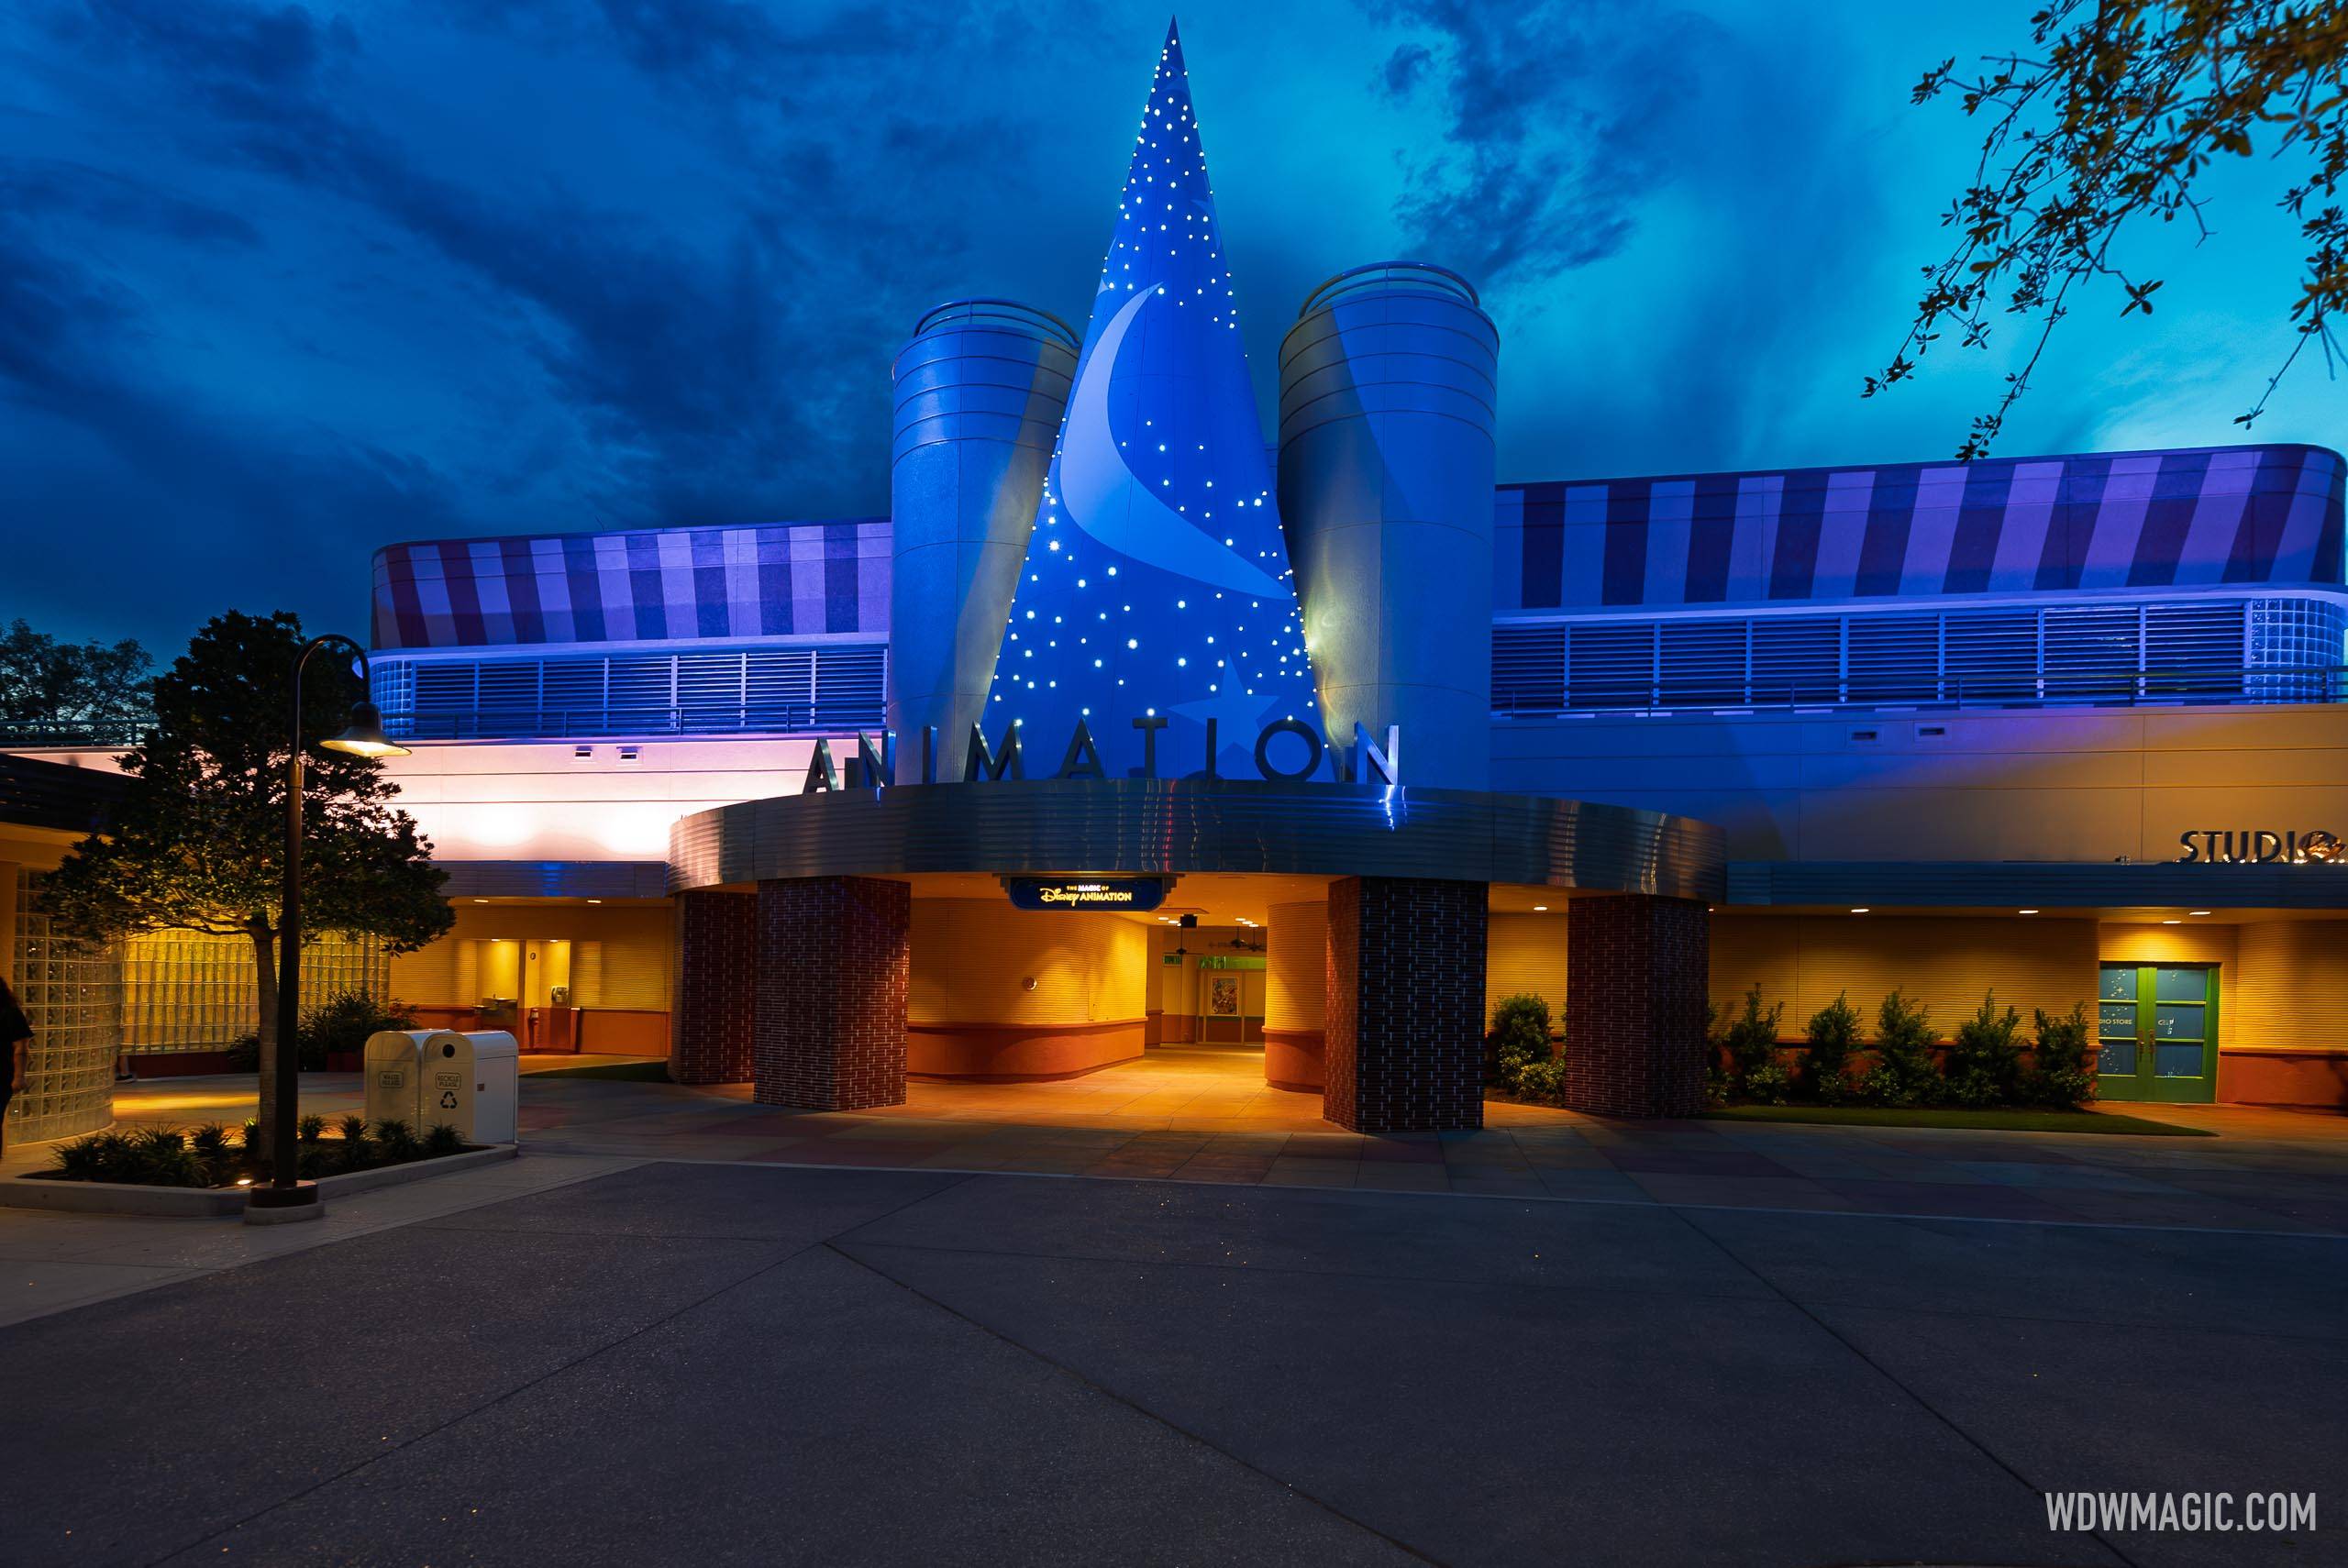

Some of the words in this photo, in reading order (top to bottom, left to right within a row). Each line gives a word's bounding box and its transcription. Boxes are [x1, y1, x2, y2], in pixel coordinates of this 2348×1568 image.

[803, 718, 1399, 796] ANIMATION
[1078, 884, 1101, 892] MAGIC
[1079, 892, 1133, 901] ANIMATION
